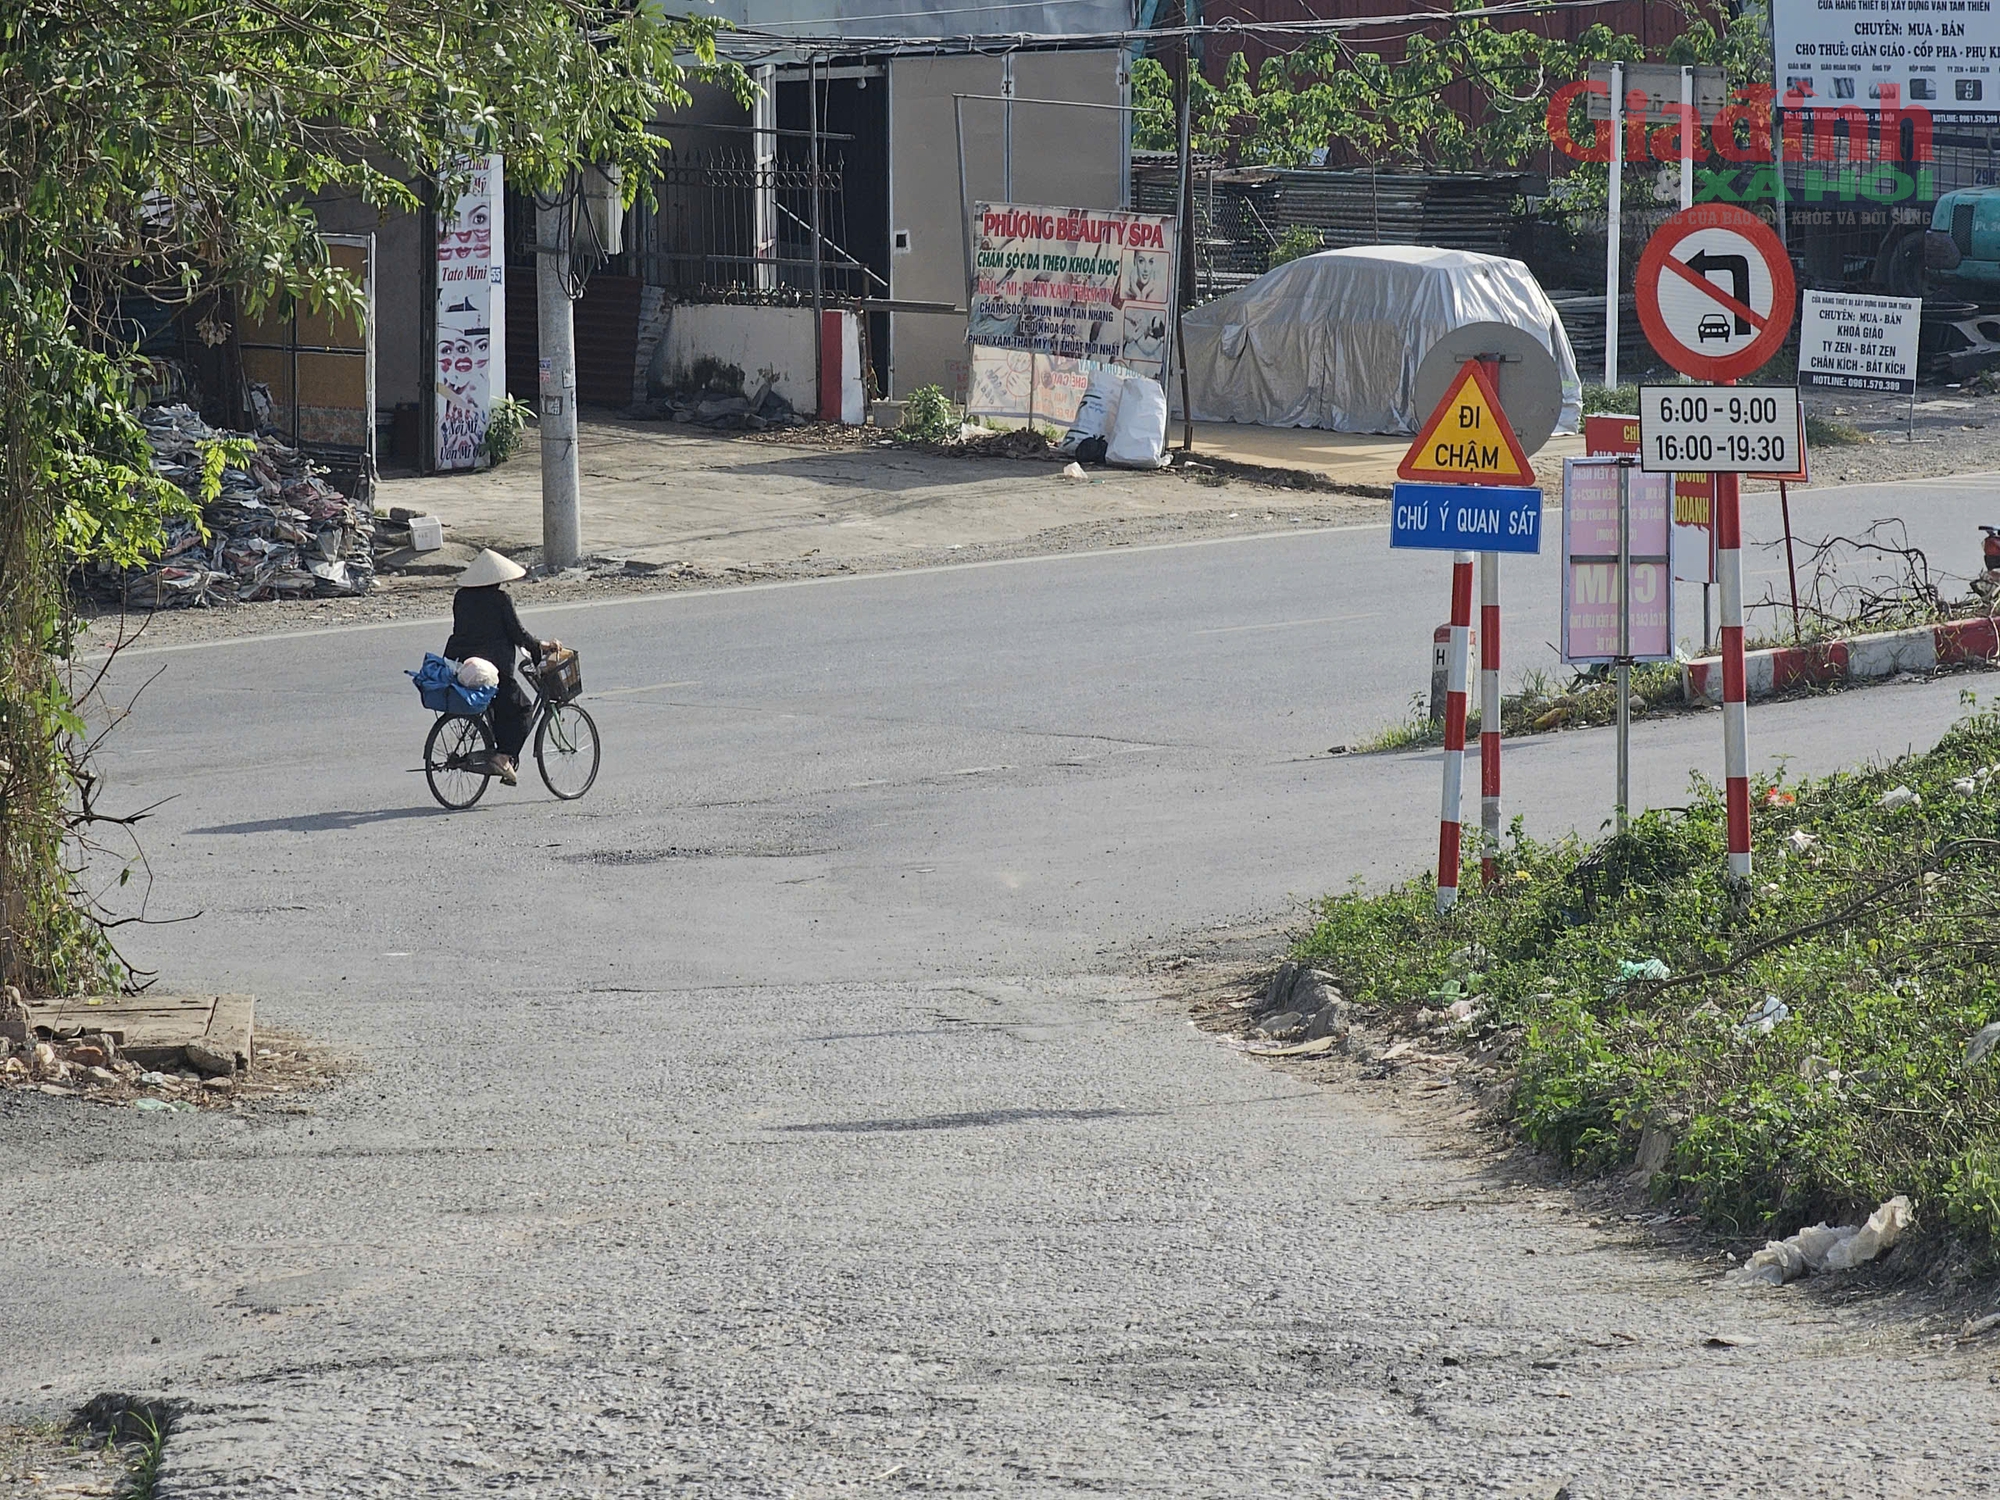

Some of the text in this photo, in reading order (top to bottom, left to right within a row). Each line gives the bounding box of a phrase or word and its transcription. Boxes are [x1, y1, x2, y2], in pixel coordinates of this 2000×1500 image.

[1908, 23, 1933, 36] MUA
[1941, 20, 1965, 36] BÁN
[1795, 43, 1816, 56] CHO
[1879, 41, 1906, 57] GIÁO
[1936, 45, 1957, 58] PHA
[1965, 46, 1987, 61] PHỤ
[983, 210, 1164, 249] PHƯỢNG BEAUTY SPA
[1027, 254, 1039, 271] DA
[1042, 255, 1067, 273] THEO
[442, 265, 488, 282] Tato Mini
[1006, 281, 1017, 296] MI
[1859, 312, 1877, 323] MUA
[1884, 312, 1902, 325] BÁN
[1863, 326, 1884, 340] GIÁO
[1822, 340, 1896, 357] TY ZEN BÁT ZEN
[1811, 355, 1906, 375] CHÂN KÍCH BÁT KÍCH
[1812, 375, 1847, 387] HOTLINE:
[1459, 406, 1480, 429] ĐI
[1660, 397, 1708, 423] 6:00
[1729, 397, 1777, 424] 9:00
[1435, 440, 1499, 472] CHẬM
[1397, 500, 1537, 536] CHÚ Ý QUAN SÁT
[1436, 648, 1446, 665] H
